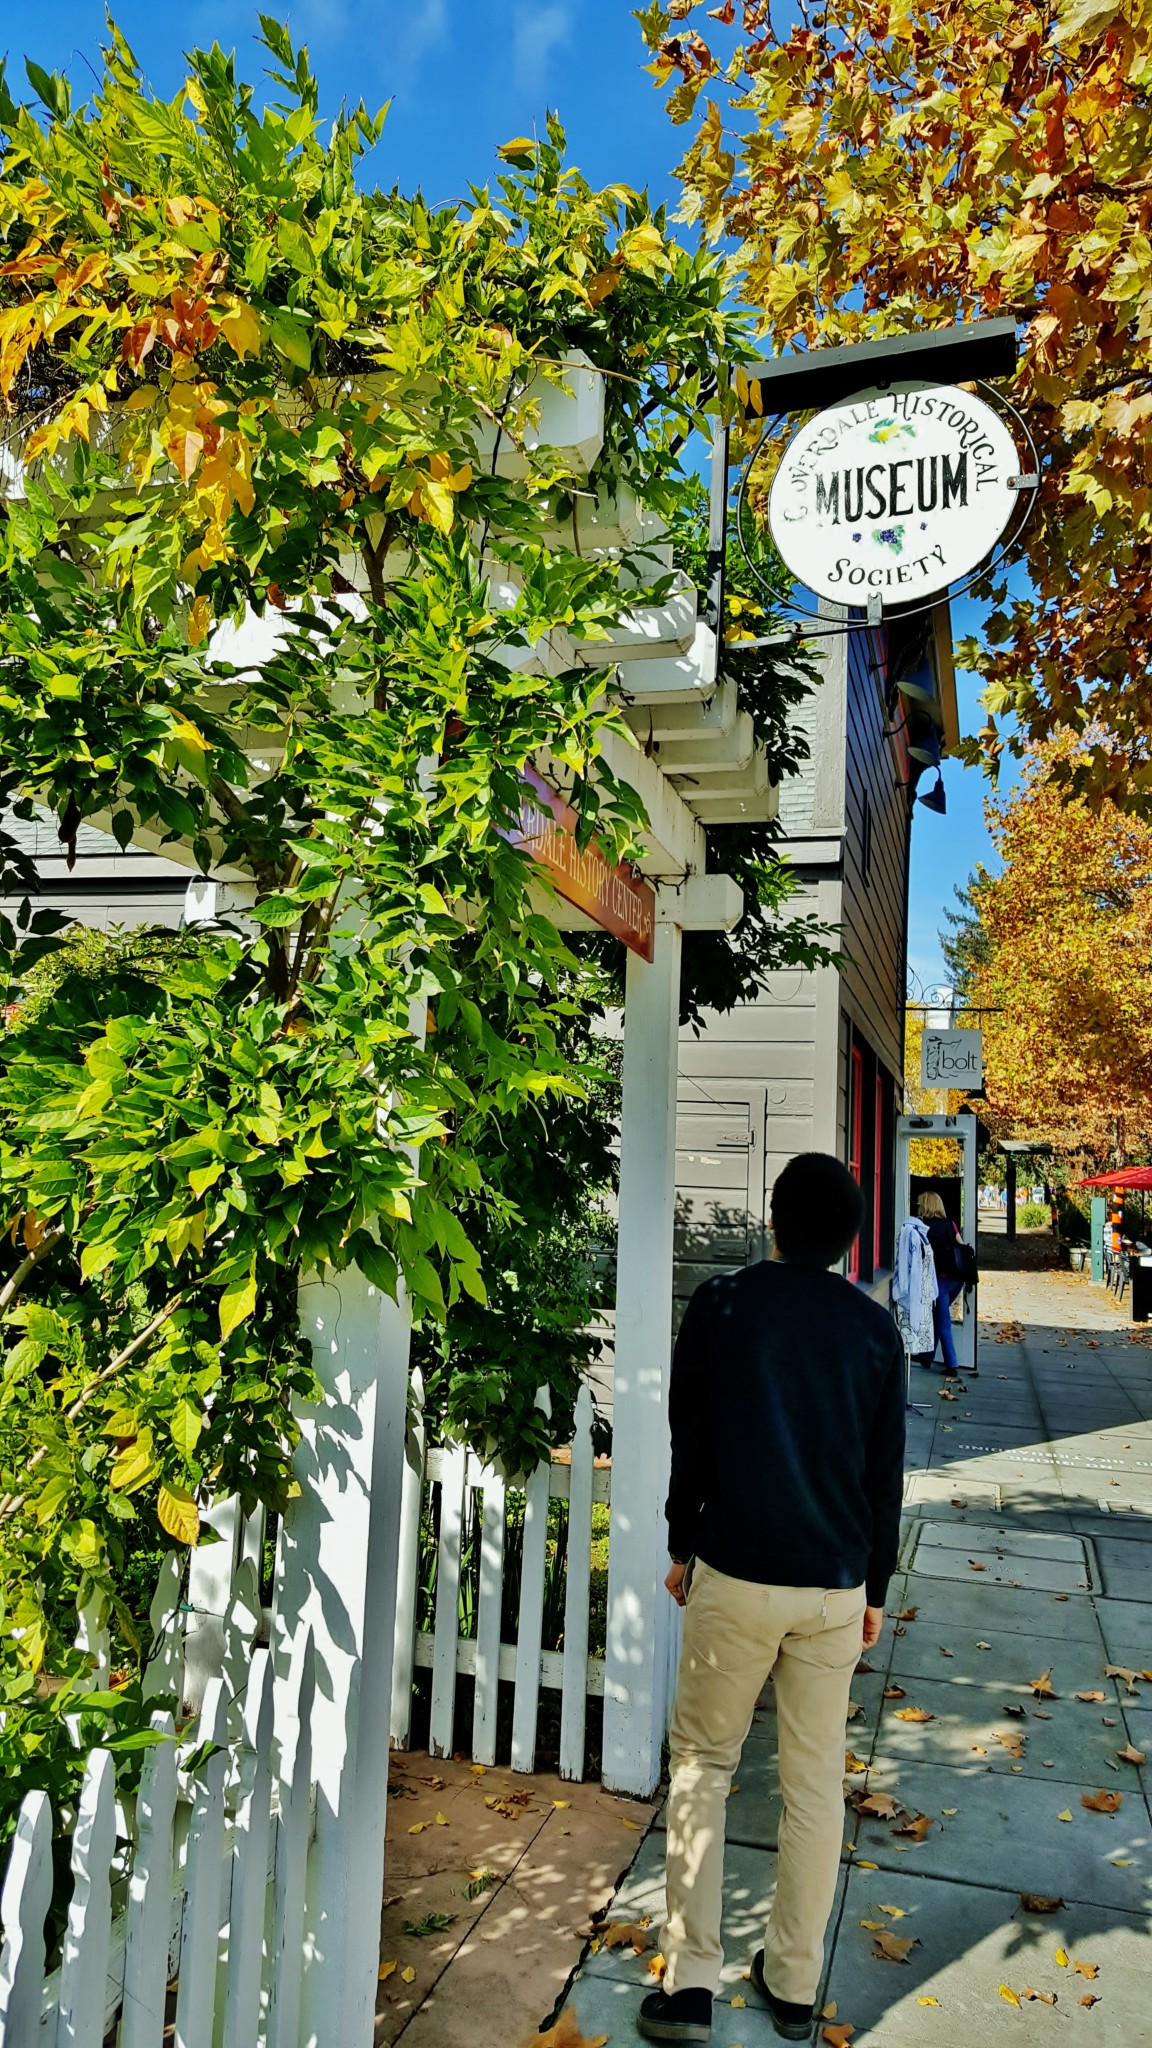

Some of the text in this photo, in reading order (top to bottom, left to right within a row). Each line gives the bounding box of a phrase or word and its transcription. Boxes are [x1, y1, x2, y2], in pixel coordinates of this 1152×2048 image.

[783, 391, 999, 523] COVERDALE HISTORICAL
[815, 450, 969, 528] MUSEUM
[827, 544, 947, 587] SOCIETY
[569, 835, 612, 907] HISTORY
[611, 875, 643, 939] CENTER
[942, 1050, 978, 1070] bolt
